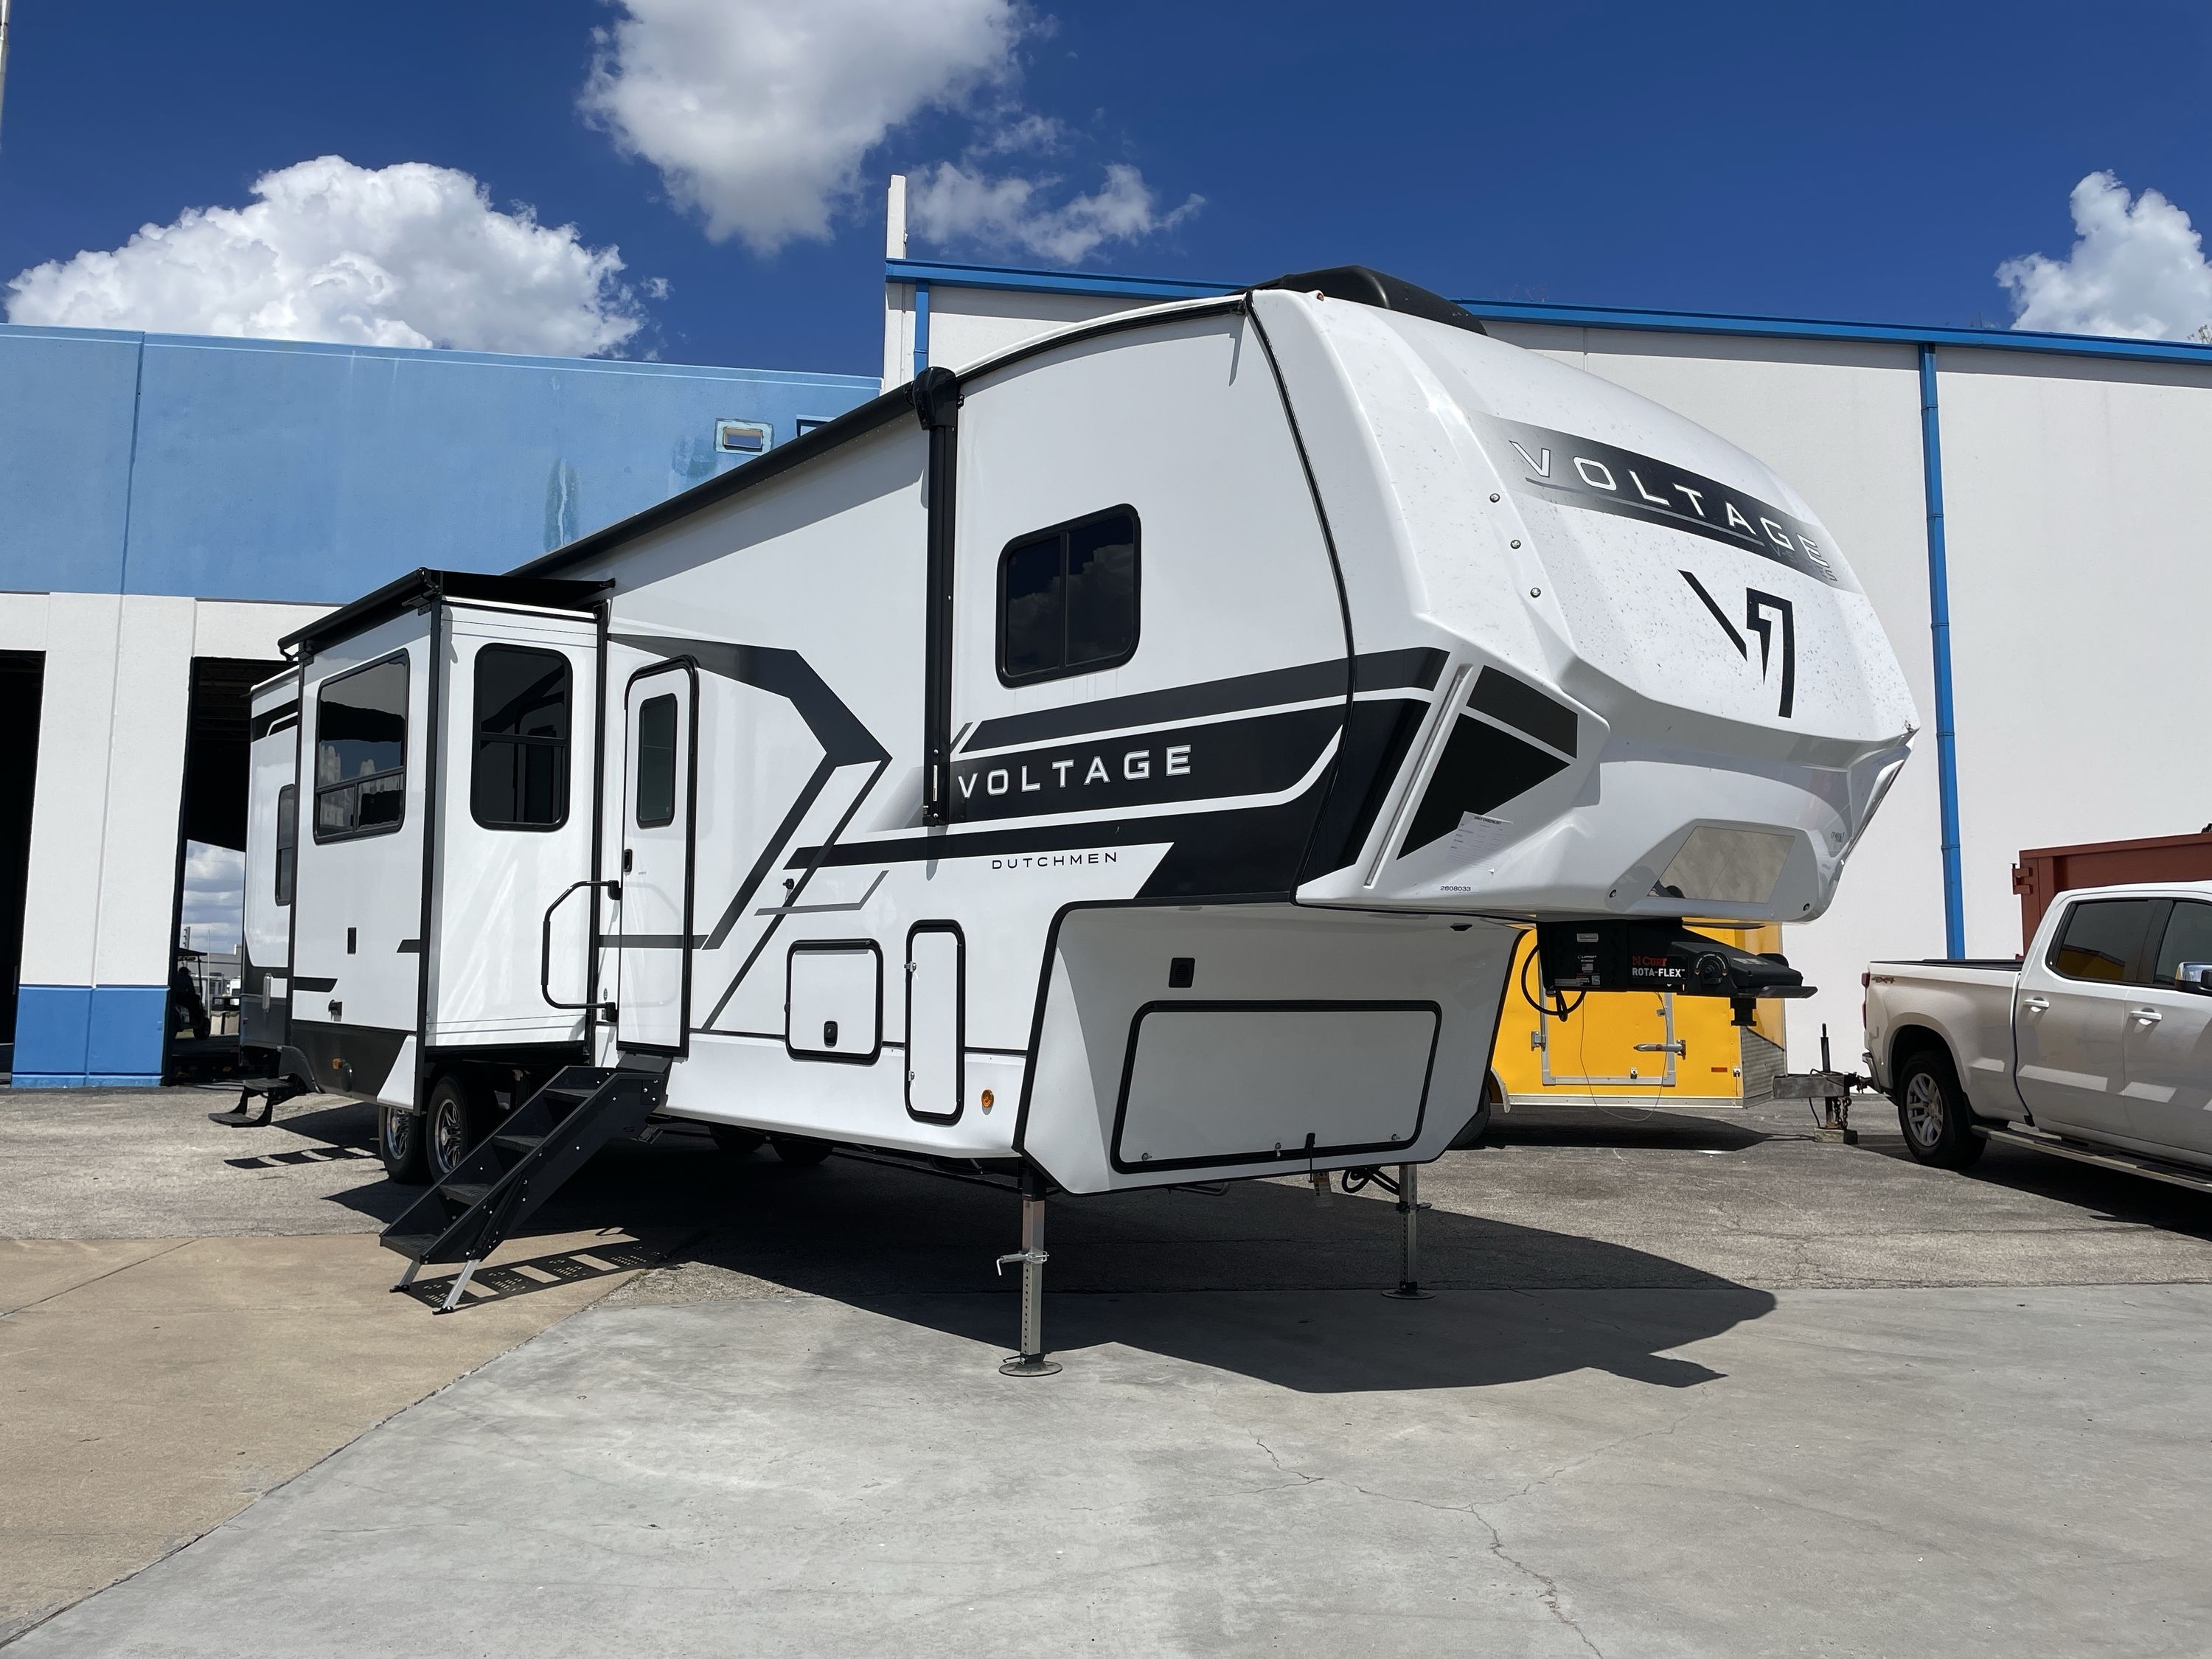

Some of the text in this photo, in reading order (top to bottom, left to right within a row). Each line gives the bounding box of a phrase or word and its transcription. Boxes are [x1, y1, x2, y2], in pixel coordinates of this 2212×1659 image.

[1509, 439, 1830, 568] VOLTAGE
[958, 745, 1192, 799] VOLTAGE
[992, 852, 1117, 870] DUTCHMEN
